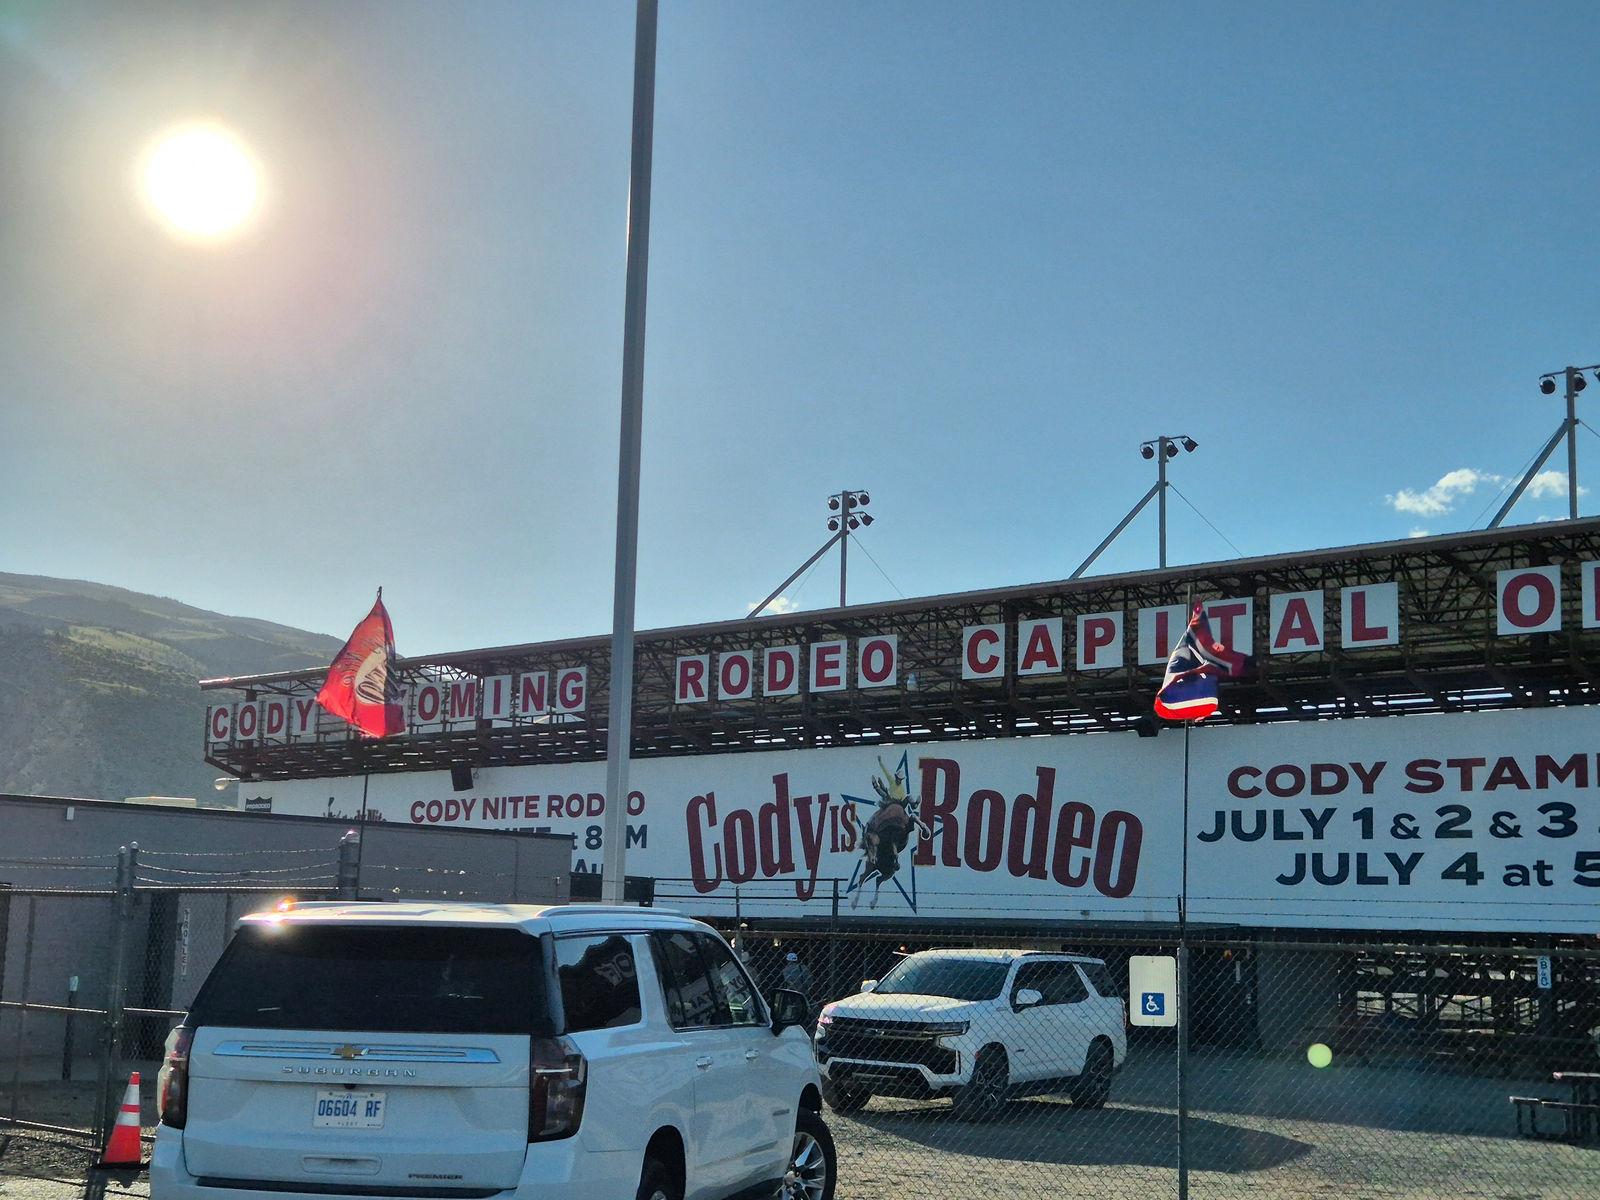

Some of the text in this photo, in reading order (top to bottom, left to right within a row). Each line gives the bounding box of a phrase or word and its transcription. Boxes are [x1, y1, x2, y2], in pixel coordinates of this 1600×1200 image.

[212, 699, 314, 738] CODY
[398, 671, 586, 722] OMING
[679, 639, 894, 699] RODEO
[966, 590, 1389, 674] CAPITAL
[1502, 566, 1600, 628] O
[1227, 753, 1600, 799] CODY STAM
[410, 798, 477, 824] CODY
[482, 795, 540, 820] NITE
[547, 790, 645, 818] RODO
[1197, 802, 1578, 843] JULY 1 & 2 & 3
[585, 824, 648, 850] 8M
[686, 758, 1144, 902] Cody IS Rodeo
[1275, 852, 1425, 887] JULY
[1441, 852, 1485, 886] 4
[1502, 859, 1554, 887] at
[282, 1065, 417, 1078] SUBURBAN
[317, 1099, 382, 1118] 06604 RF
